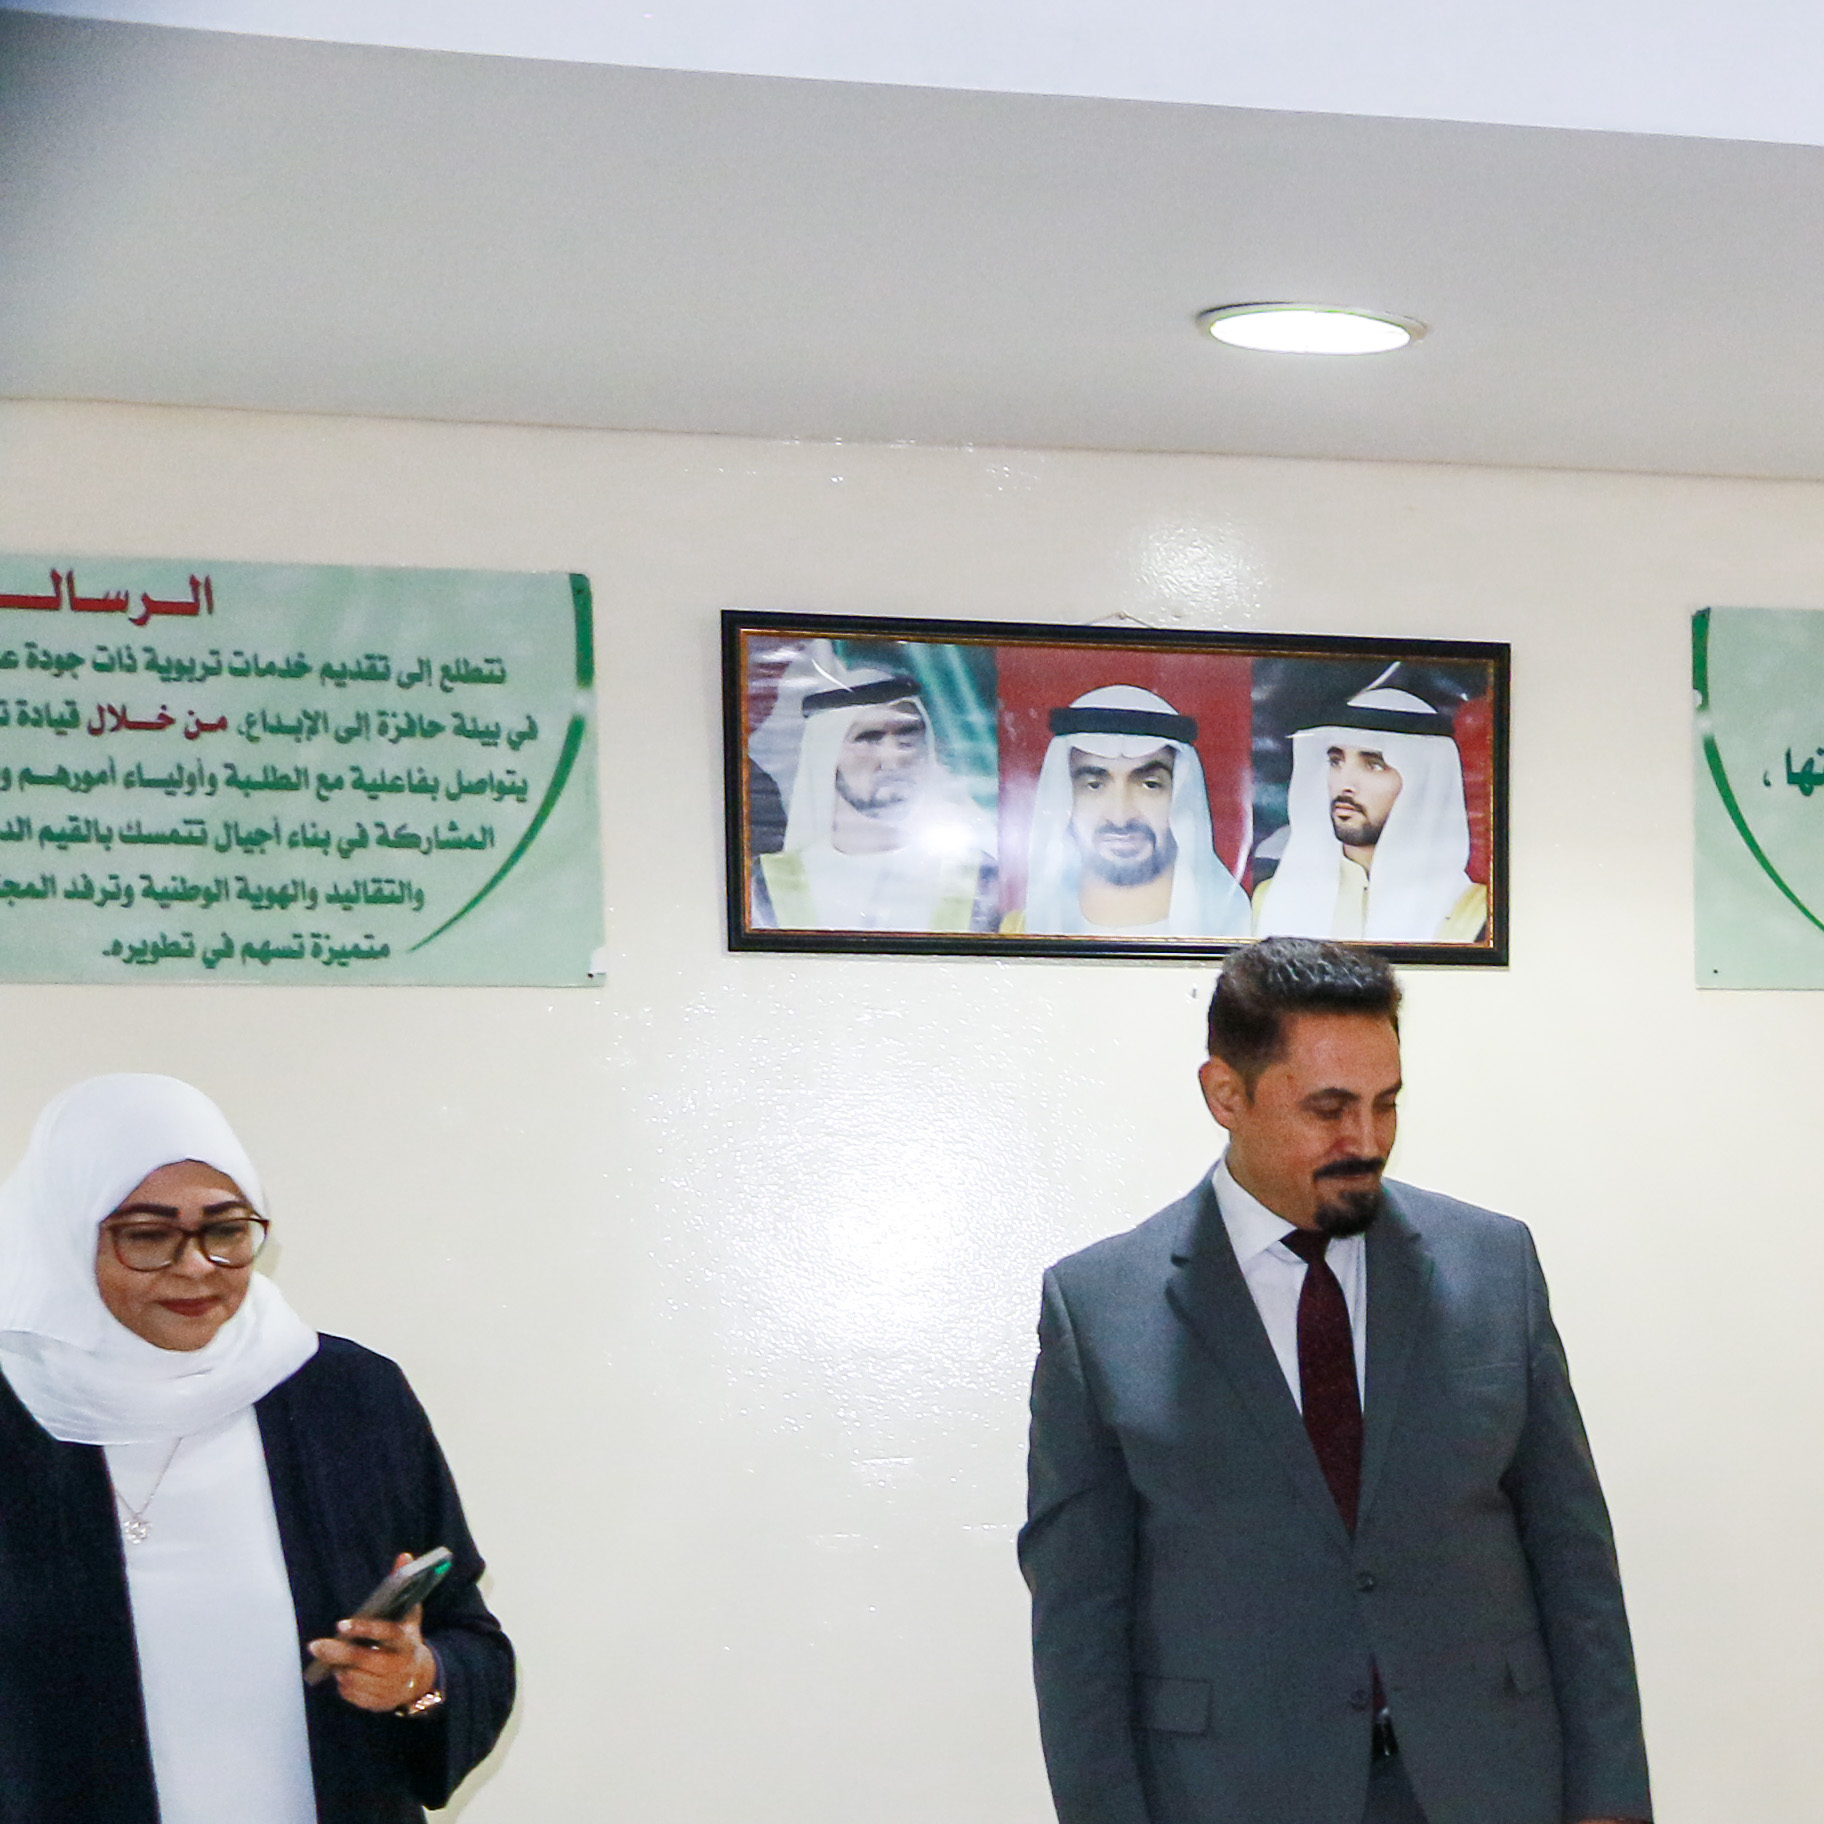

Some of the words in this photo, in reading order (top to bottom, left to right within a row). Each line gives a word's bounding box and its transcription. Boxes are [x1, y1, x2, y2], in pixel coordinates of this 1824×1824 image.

[0, 568, 214, 627] الرسال
[228, 649, 313, 681] خدمات
[319, 652, 391, 687] تقديم
[87, 702, 177, 737] خلال
[183, 709, 229, 741] من
[506, 713, 539, 751] في
[223, 762, 310, 799] الطلبة
[315, 771, 345, 802] مع
[287, 820, 332, 857] بناء
[336, 821, 370, 860] في
[201, 930, 236, 969] في
